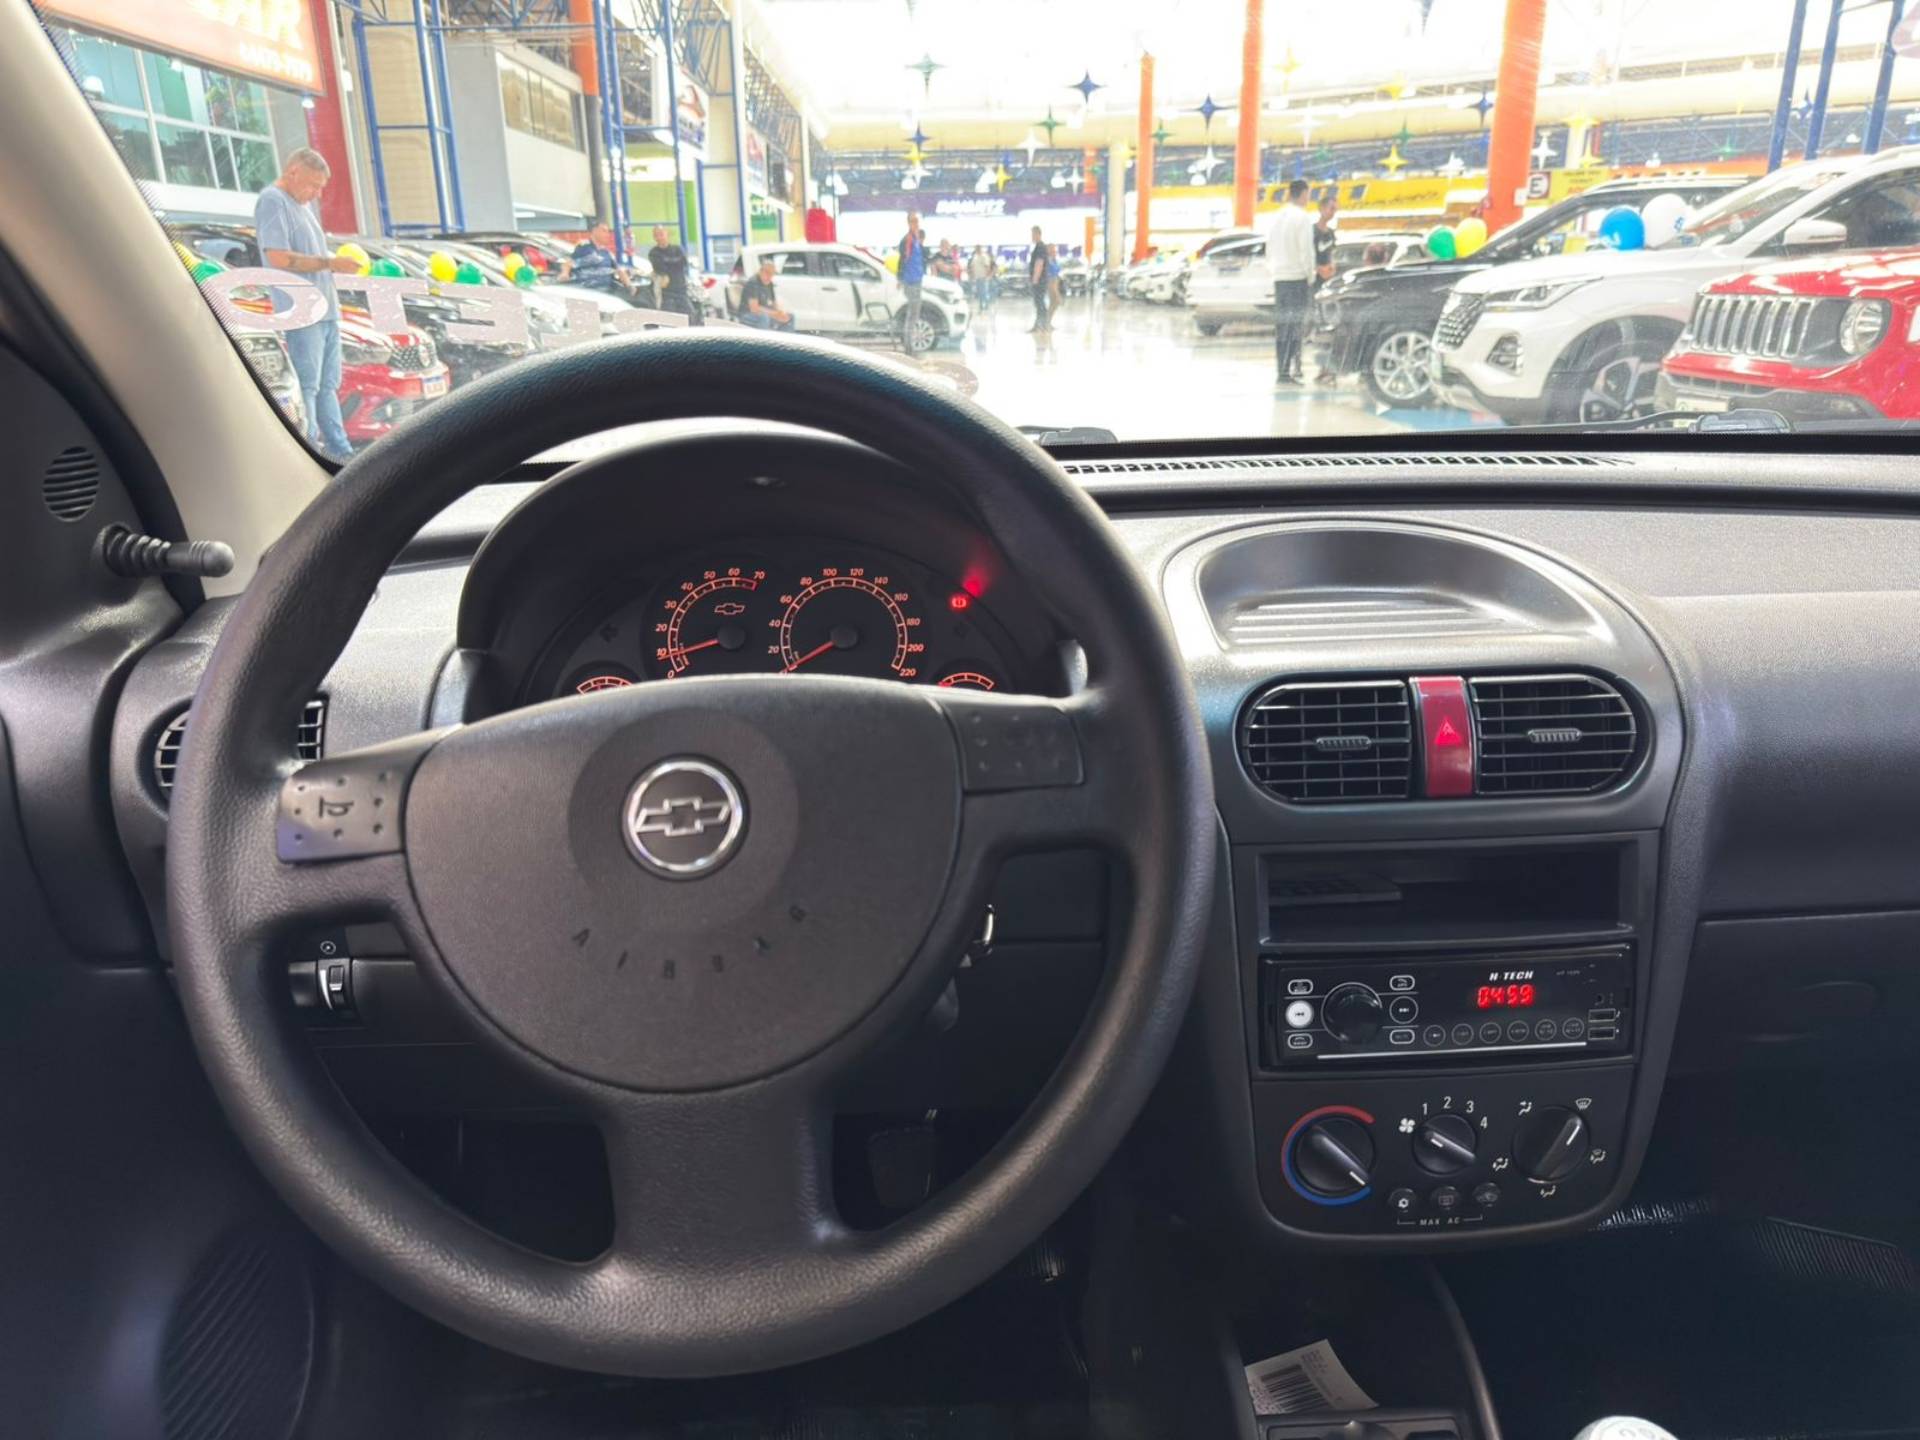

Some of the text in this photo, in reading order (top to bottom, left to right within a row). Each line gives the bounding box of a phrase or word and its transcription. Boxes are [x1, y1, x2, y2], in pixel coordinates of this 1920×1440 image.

[823, 568, 837, 576] 100
[850, 568, 863, 576] 120
[800, 577, 812, 585] 80
[780, 595, 792, 603] 60
[656, 568, 765, 679] 0 10 20 30 40 50 60 70
[769, 619, 780, 627] 40
[768, 645, 779, 653] 20
[908, 644, 923, 652] 200
[900, 668, 915, 676] 220
[1503, 970, 1534, 981] TECH
[1422, 1096, 1488, 1129] 1 2 3 4
[1420, 1216, 1461, 1226] MAX AC
